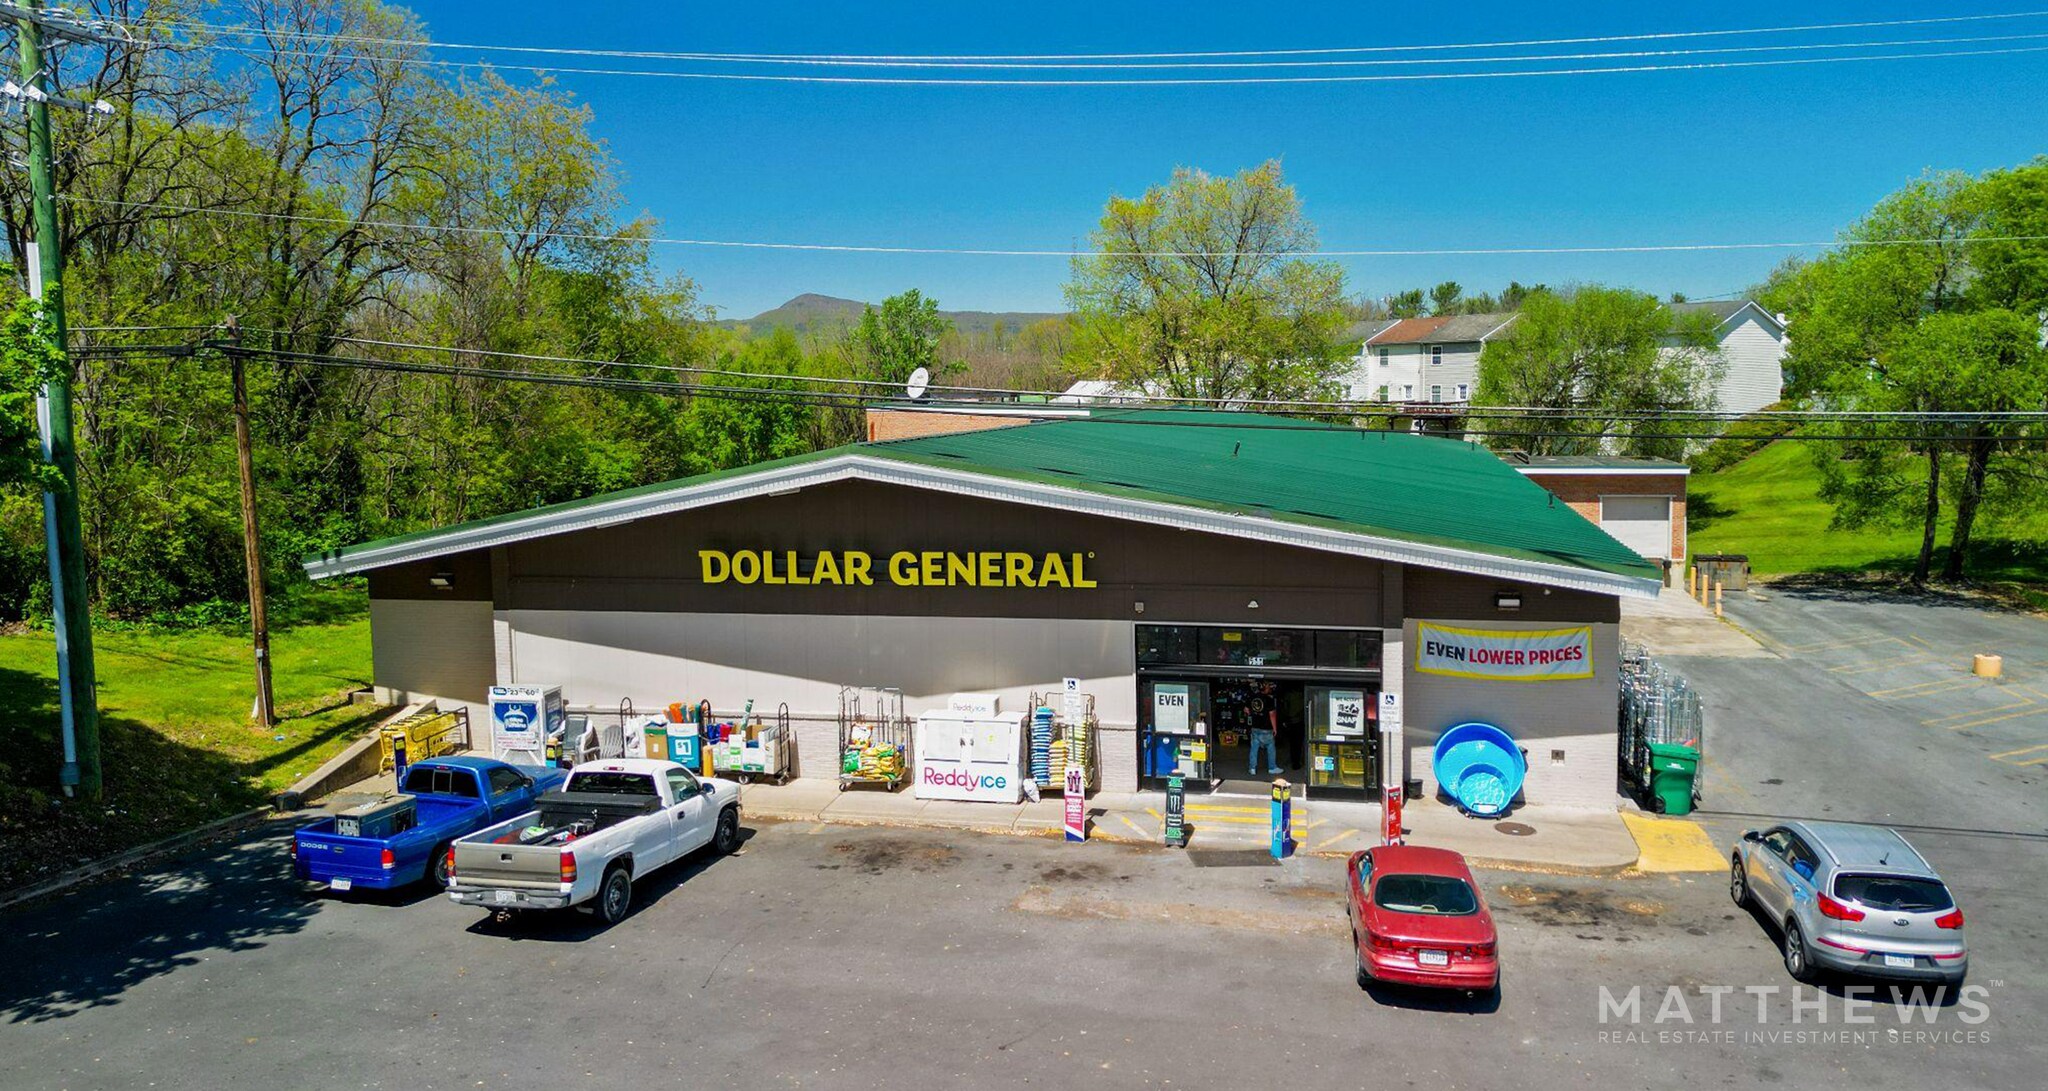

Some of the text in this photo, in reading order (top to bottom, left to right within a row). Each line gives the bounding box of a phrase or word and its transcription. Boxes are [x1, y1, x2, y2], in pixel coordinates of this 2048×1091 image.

[698, 550, 1097, 588] DOLLAR GENERAL
[1426, 641, 1583, 665] EVEN LOWER PRICES
[1158, 694, 1185, 707] EVEN
[301, 842, 328, 850] DODGE
